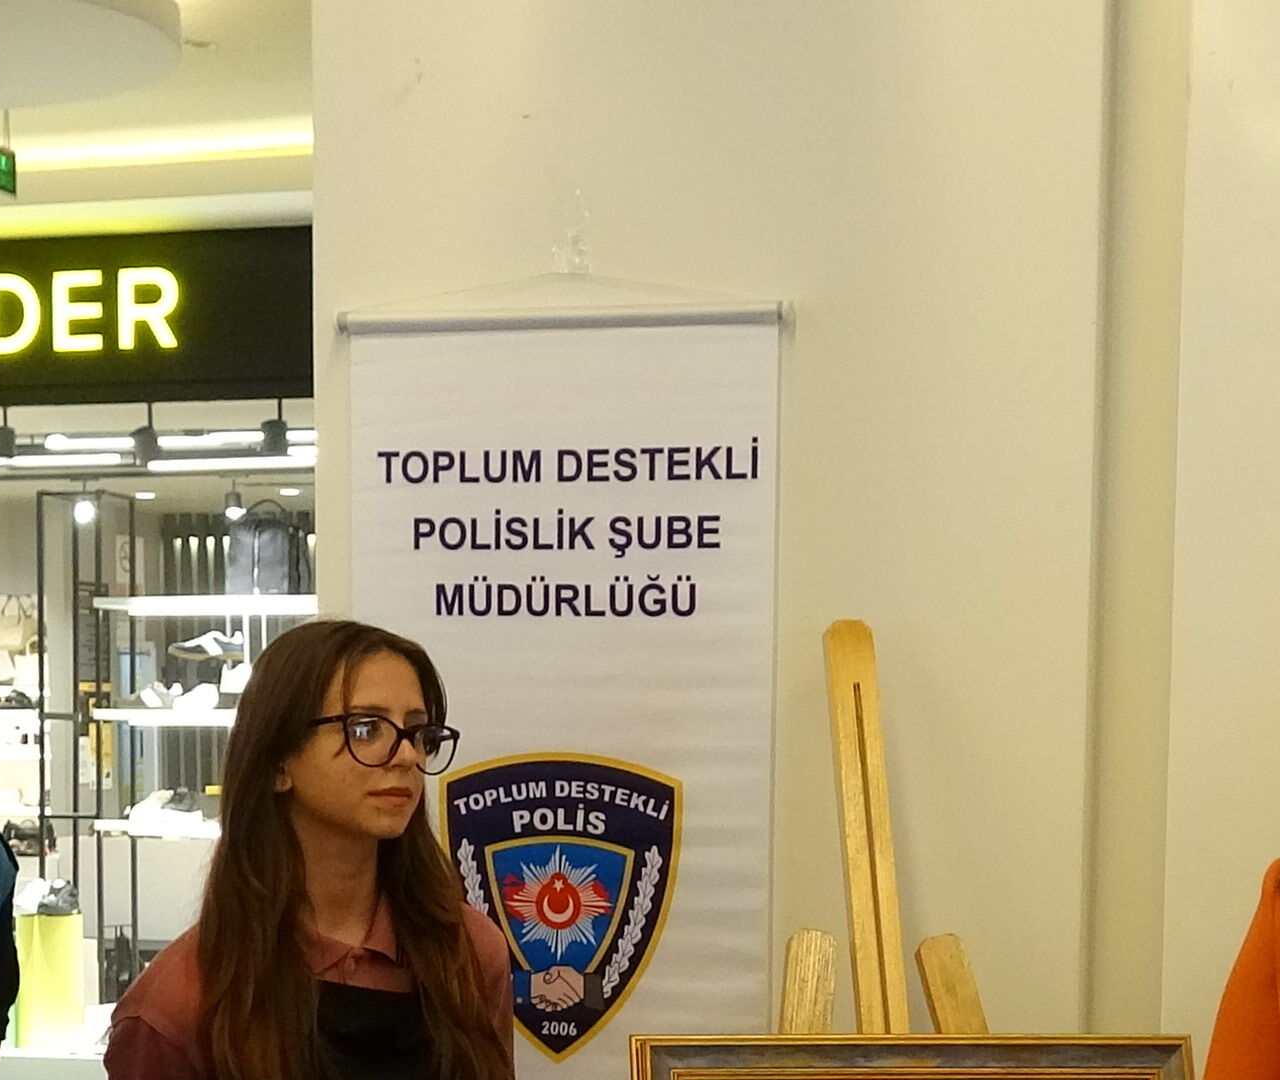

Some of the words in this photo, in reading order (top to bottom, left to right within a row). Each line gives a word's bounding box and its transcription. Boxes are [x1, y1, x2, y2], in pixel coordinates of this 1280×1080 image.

[377, 449, 542, 484] TOPLUM
[556, 436, 760, 482] DESTEKLİ
[412, 508, 595, 551] POLİSLİK
[608, 515, 721, 559] ŞUBE
[435, 574, 697, 618] MÜDÜRLÜĞÜ
[453, 781, 547, 815] TOPLUM
[555, 780, 670, 821] DESTEKLİ
[512, 803, 607, 835] POLİS
[541, 1021, 577, 1036] 2006
